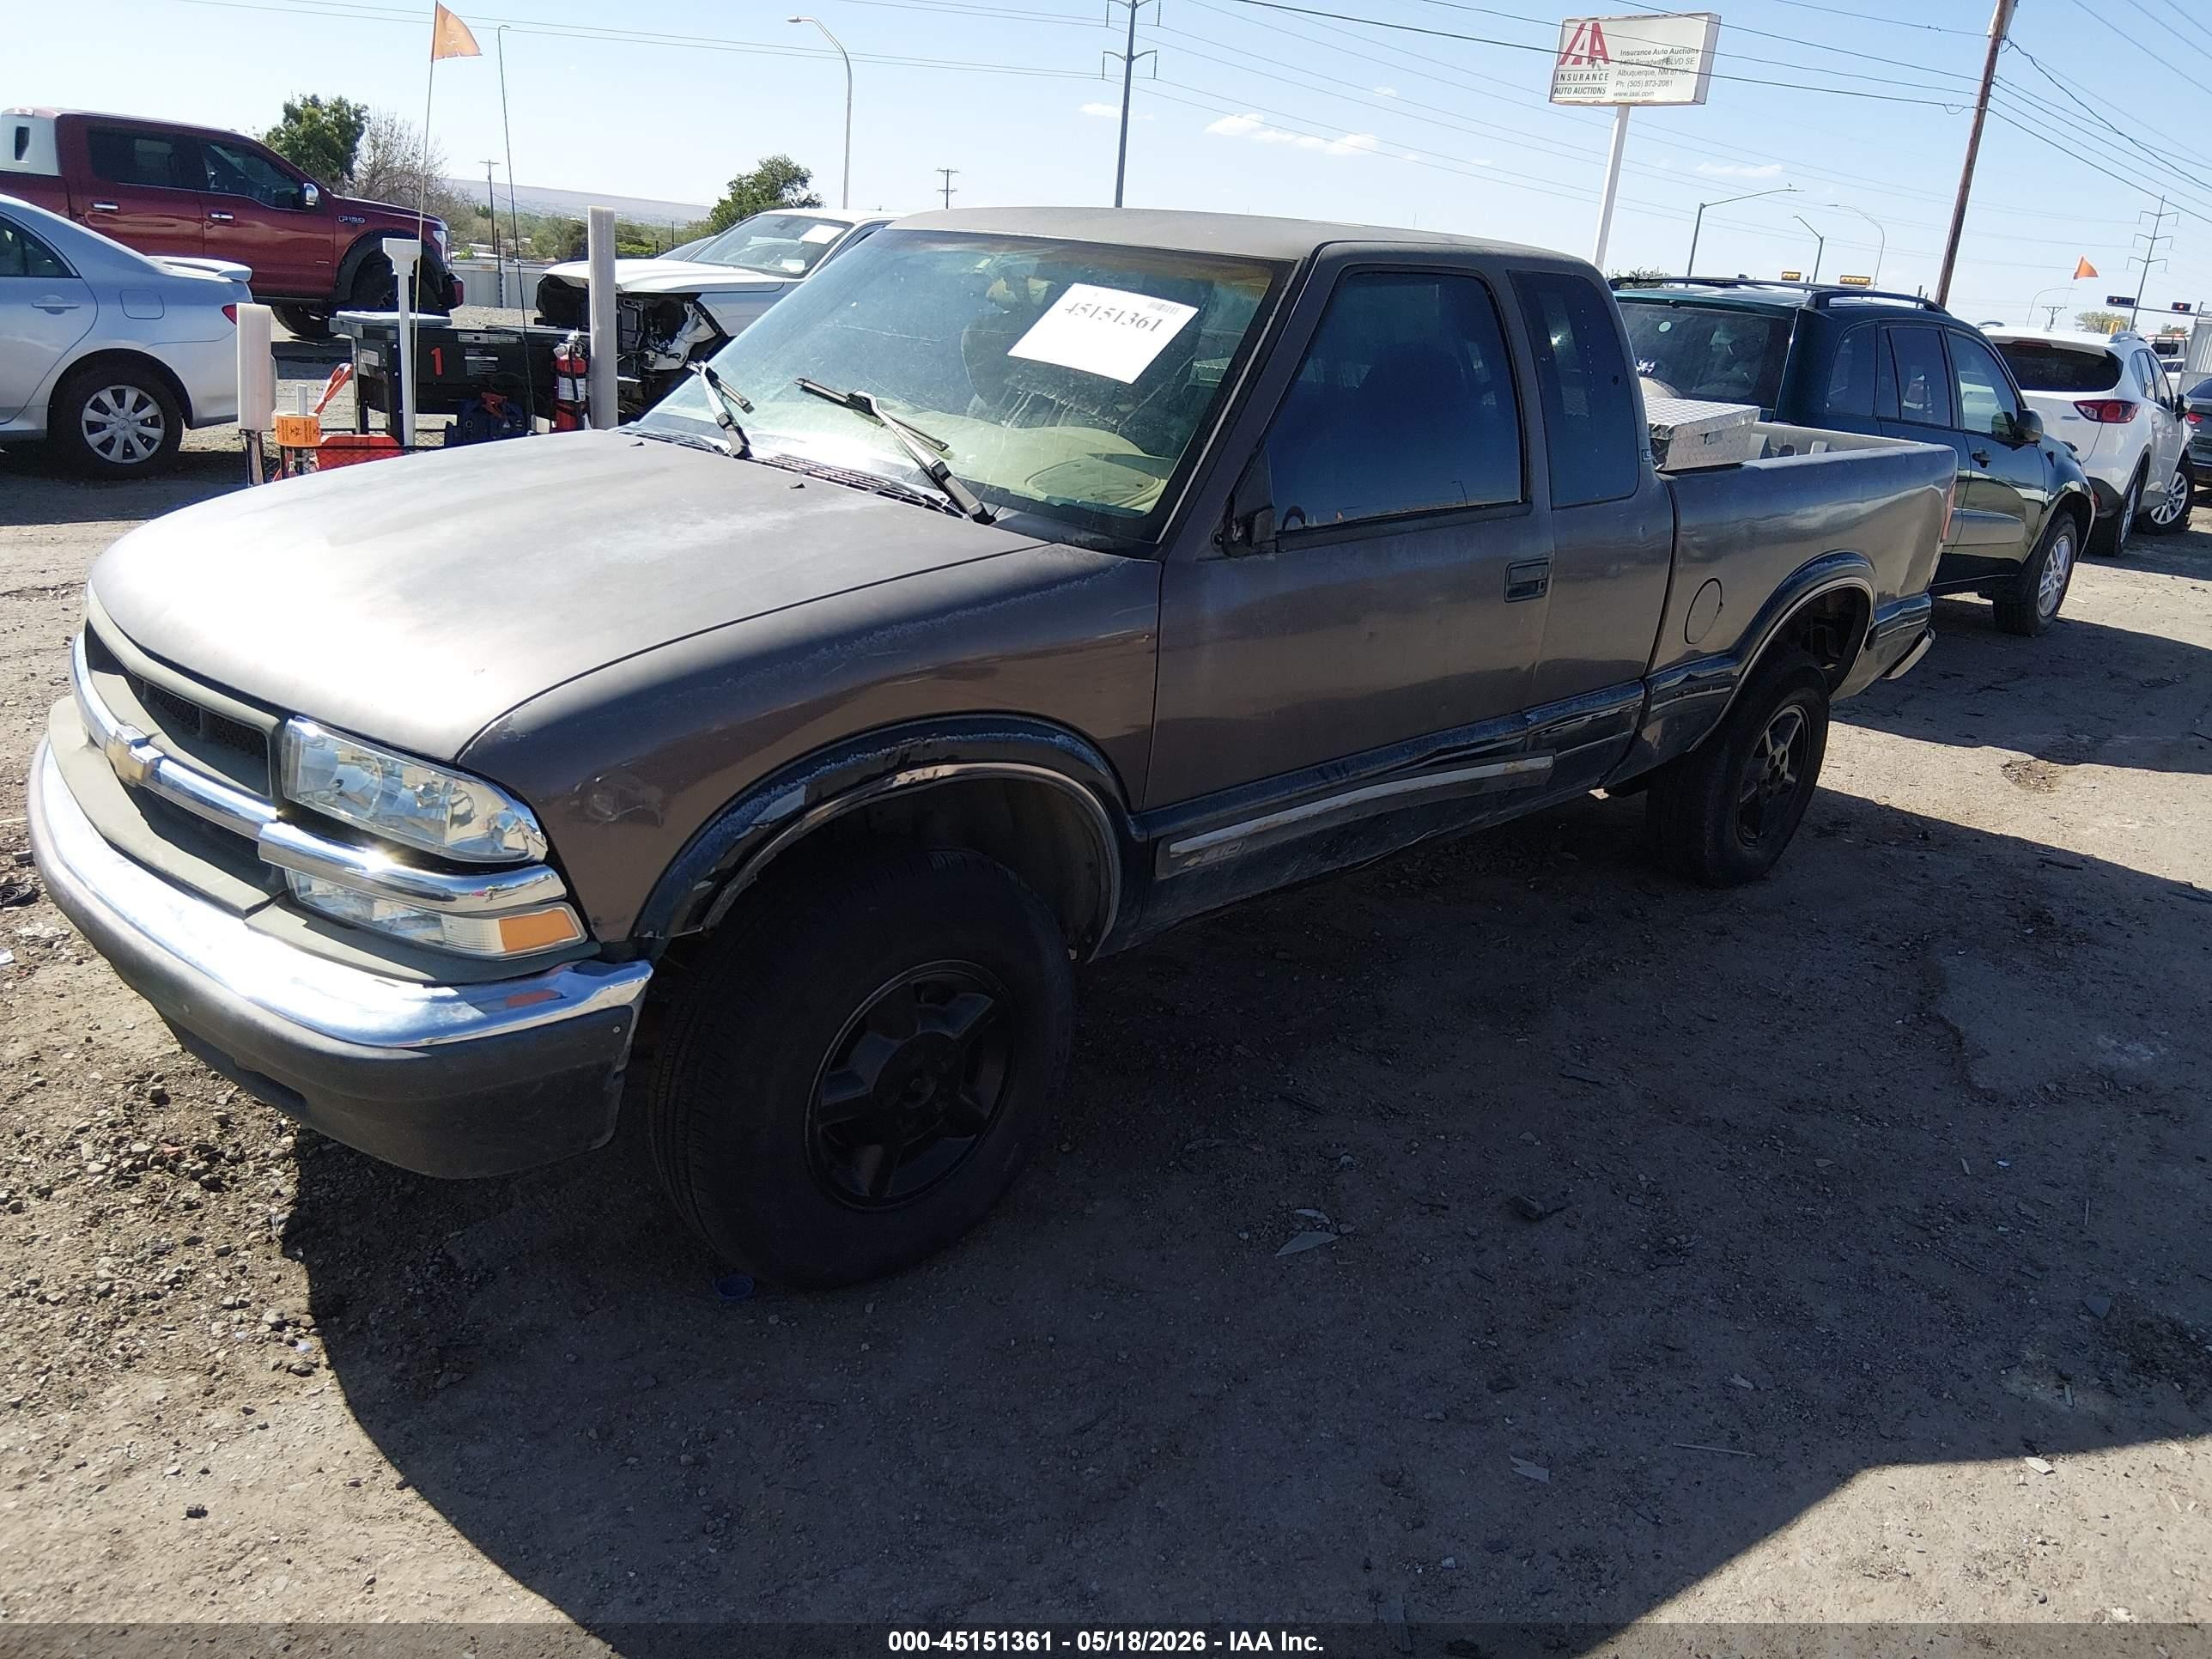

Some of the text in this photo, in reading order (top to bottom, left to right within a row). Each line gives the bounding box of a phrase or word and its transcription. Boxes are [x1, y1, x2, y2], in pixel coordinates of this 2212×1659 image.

[1685, 57, 1696, 65] SE
[1555, 72, 1609, 82] INSURANCE
[1617, 69, 1656, 77] Albuquerque,
[1627, 80, 1644, 88] (505)
[1572, 87, 1607, 95] AUCTIONS
[1065, 302, 1164, 331] 45151361
